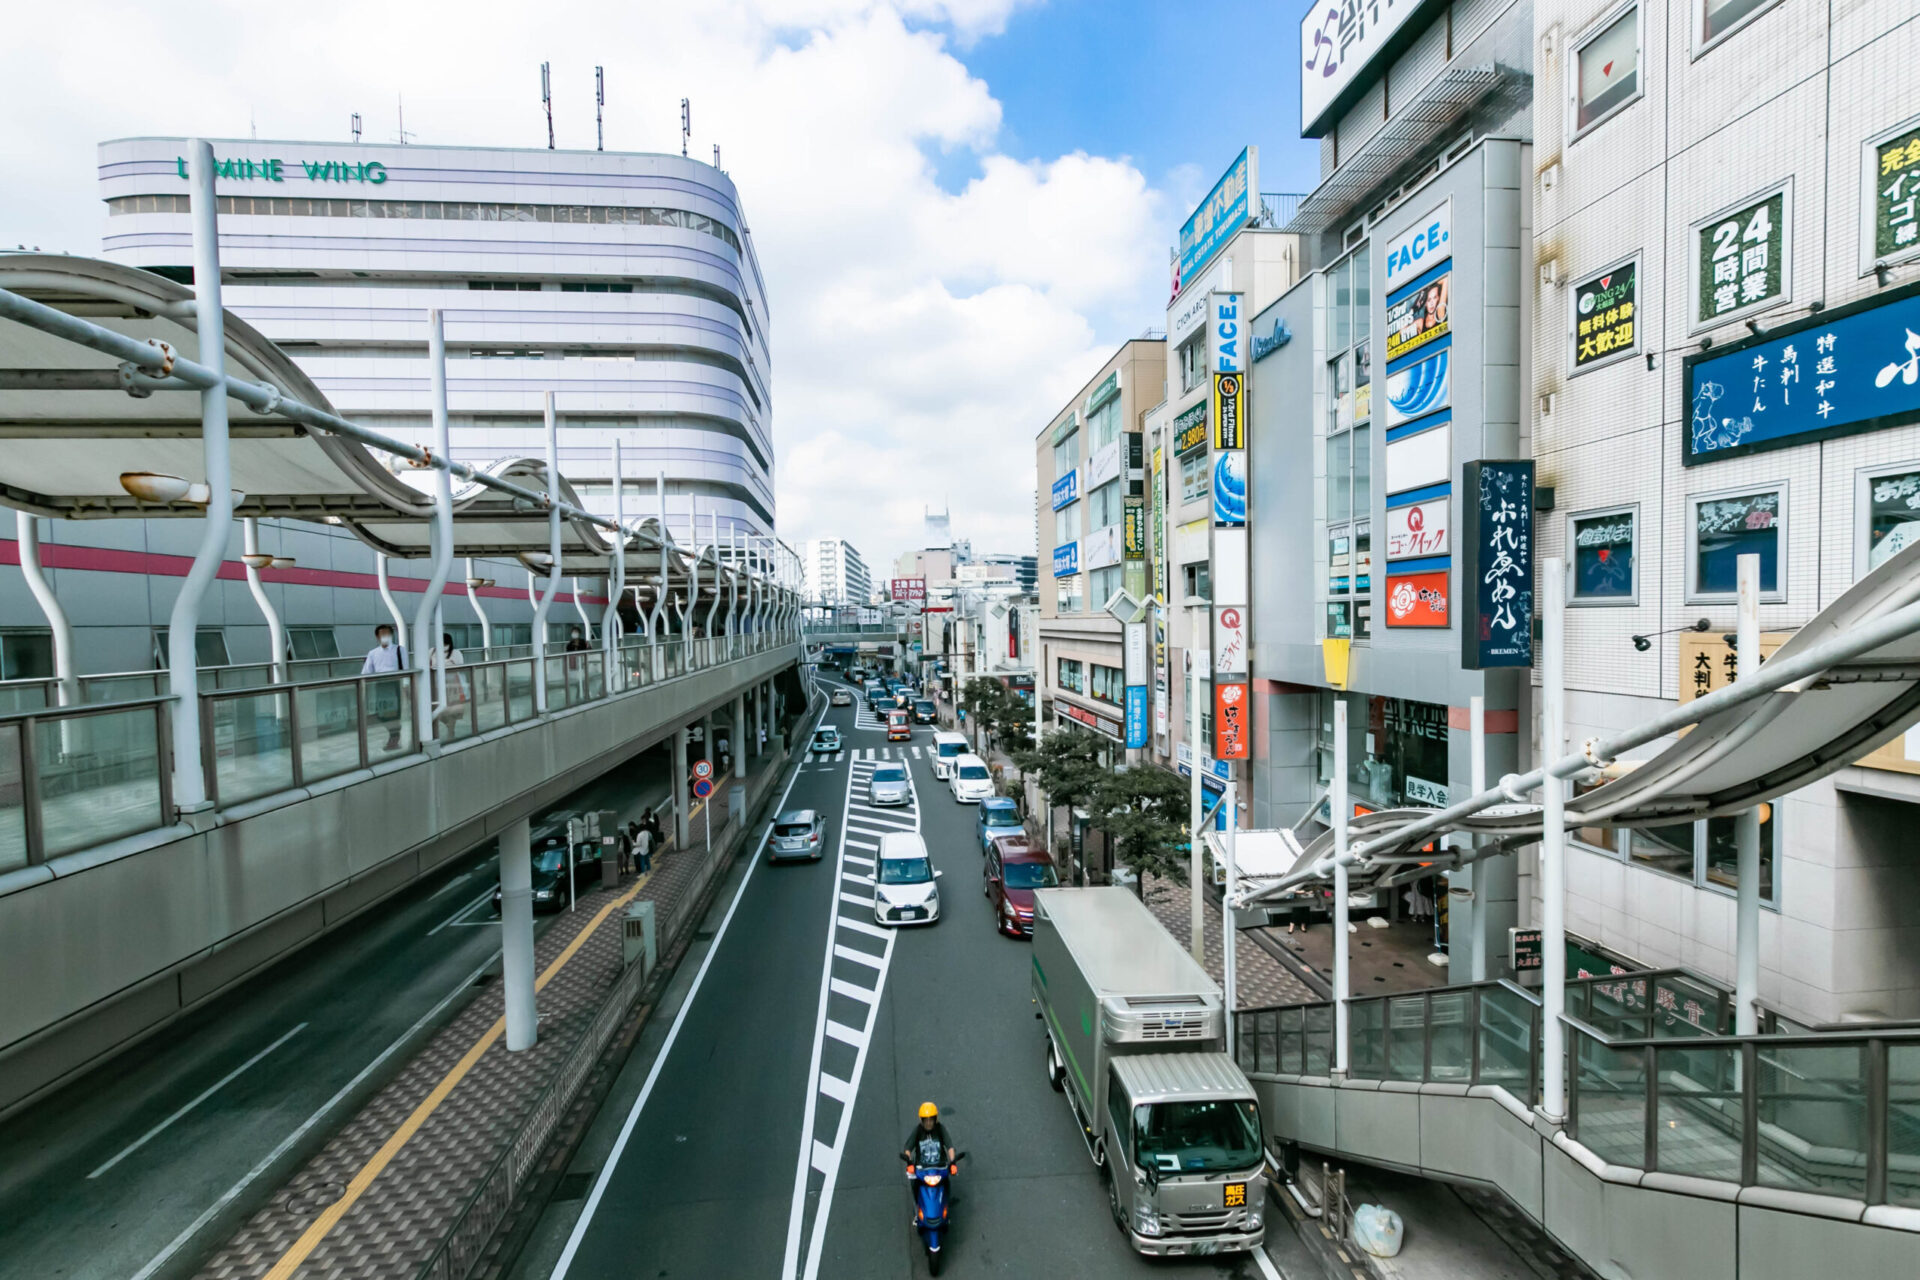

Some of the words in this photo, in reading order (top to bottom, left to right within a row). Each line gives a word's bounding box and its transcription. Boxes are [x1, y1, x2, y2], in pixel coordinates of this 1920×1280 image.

[177, 156, 284, 182] LMINE
[302, 160, 387, 184] WING
[1194, 235, 1214, 264] ESTATE
[1712, 205, 1772, 262] 24
[1714, 241, 1769, 285] 時間
[1714, 271, 1768, 314] 営業
[1579, 301, 1634, 337] 無料体験
[1579, 321, 1634, 360] 大歓迎
[1752, 354, 1768, 413] 牛たん
[1780, 344, 1800, 406] 馬刺し
[1815, 333, 1838, 420] 特選和牛
[697, 764, 709, 774] 30
[1407, 781, 1446, 804] 見学入会
[1225, 1184, 1245, 1196] 高圧
[1225, 1195, 1245, 1206] ガス
